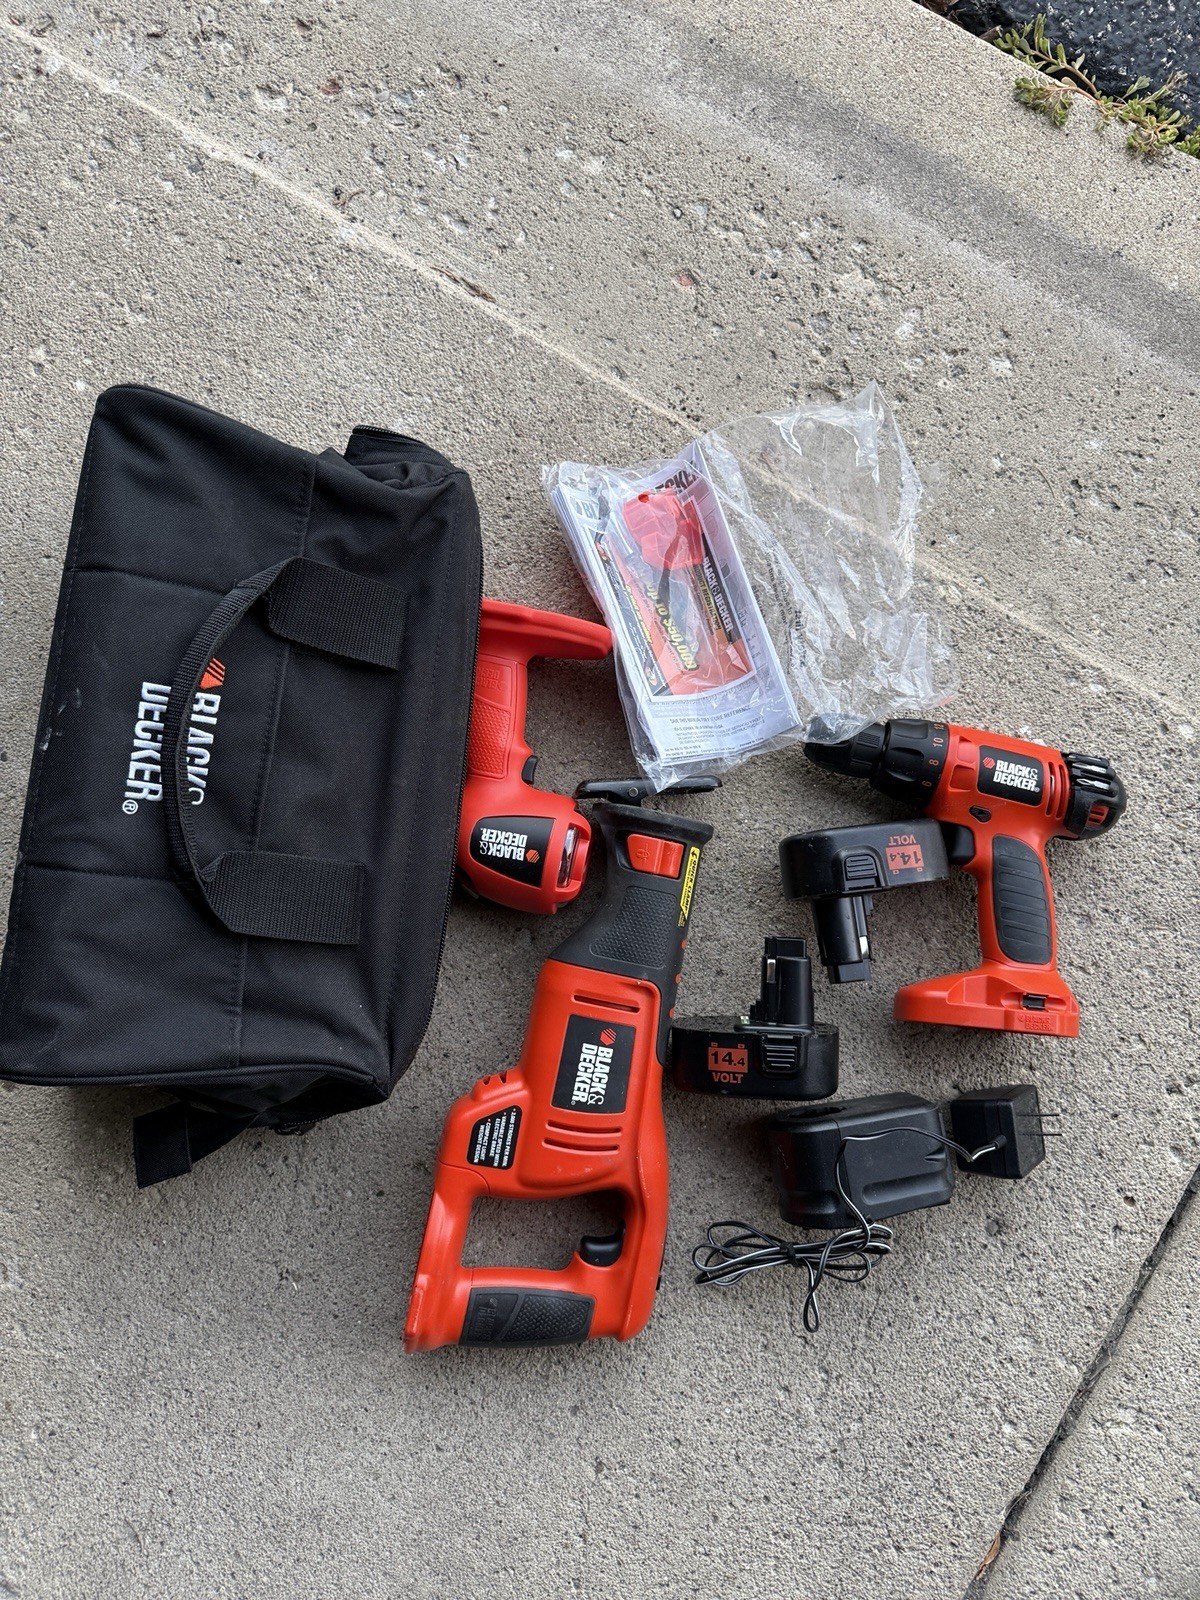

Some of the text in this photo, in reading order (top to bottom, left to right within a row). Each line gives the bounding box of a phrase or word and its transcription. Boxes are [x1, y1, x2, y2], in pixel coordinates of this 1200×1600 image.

[932, 737, 944, 747] 10
[888, 834, 917, 846] VOLT
[889, 850, 922, 865] 14.4
[710, 1050, 746, 1067] 14.4
[712, 1071, 744, 1084] VOLT
[482, 1122, 491, 1146] COMPACT
[498, 1115, 507, 1138] VARIABLE
[505, 1123, 514, 1146] STROKES
[473, 1124, 486, 1163] WEIGHT DESIGN
[489, 1118, 501, 1157] ELECTRIC BRAKE
[495, 1138, 503, 1154] SPEED
